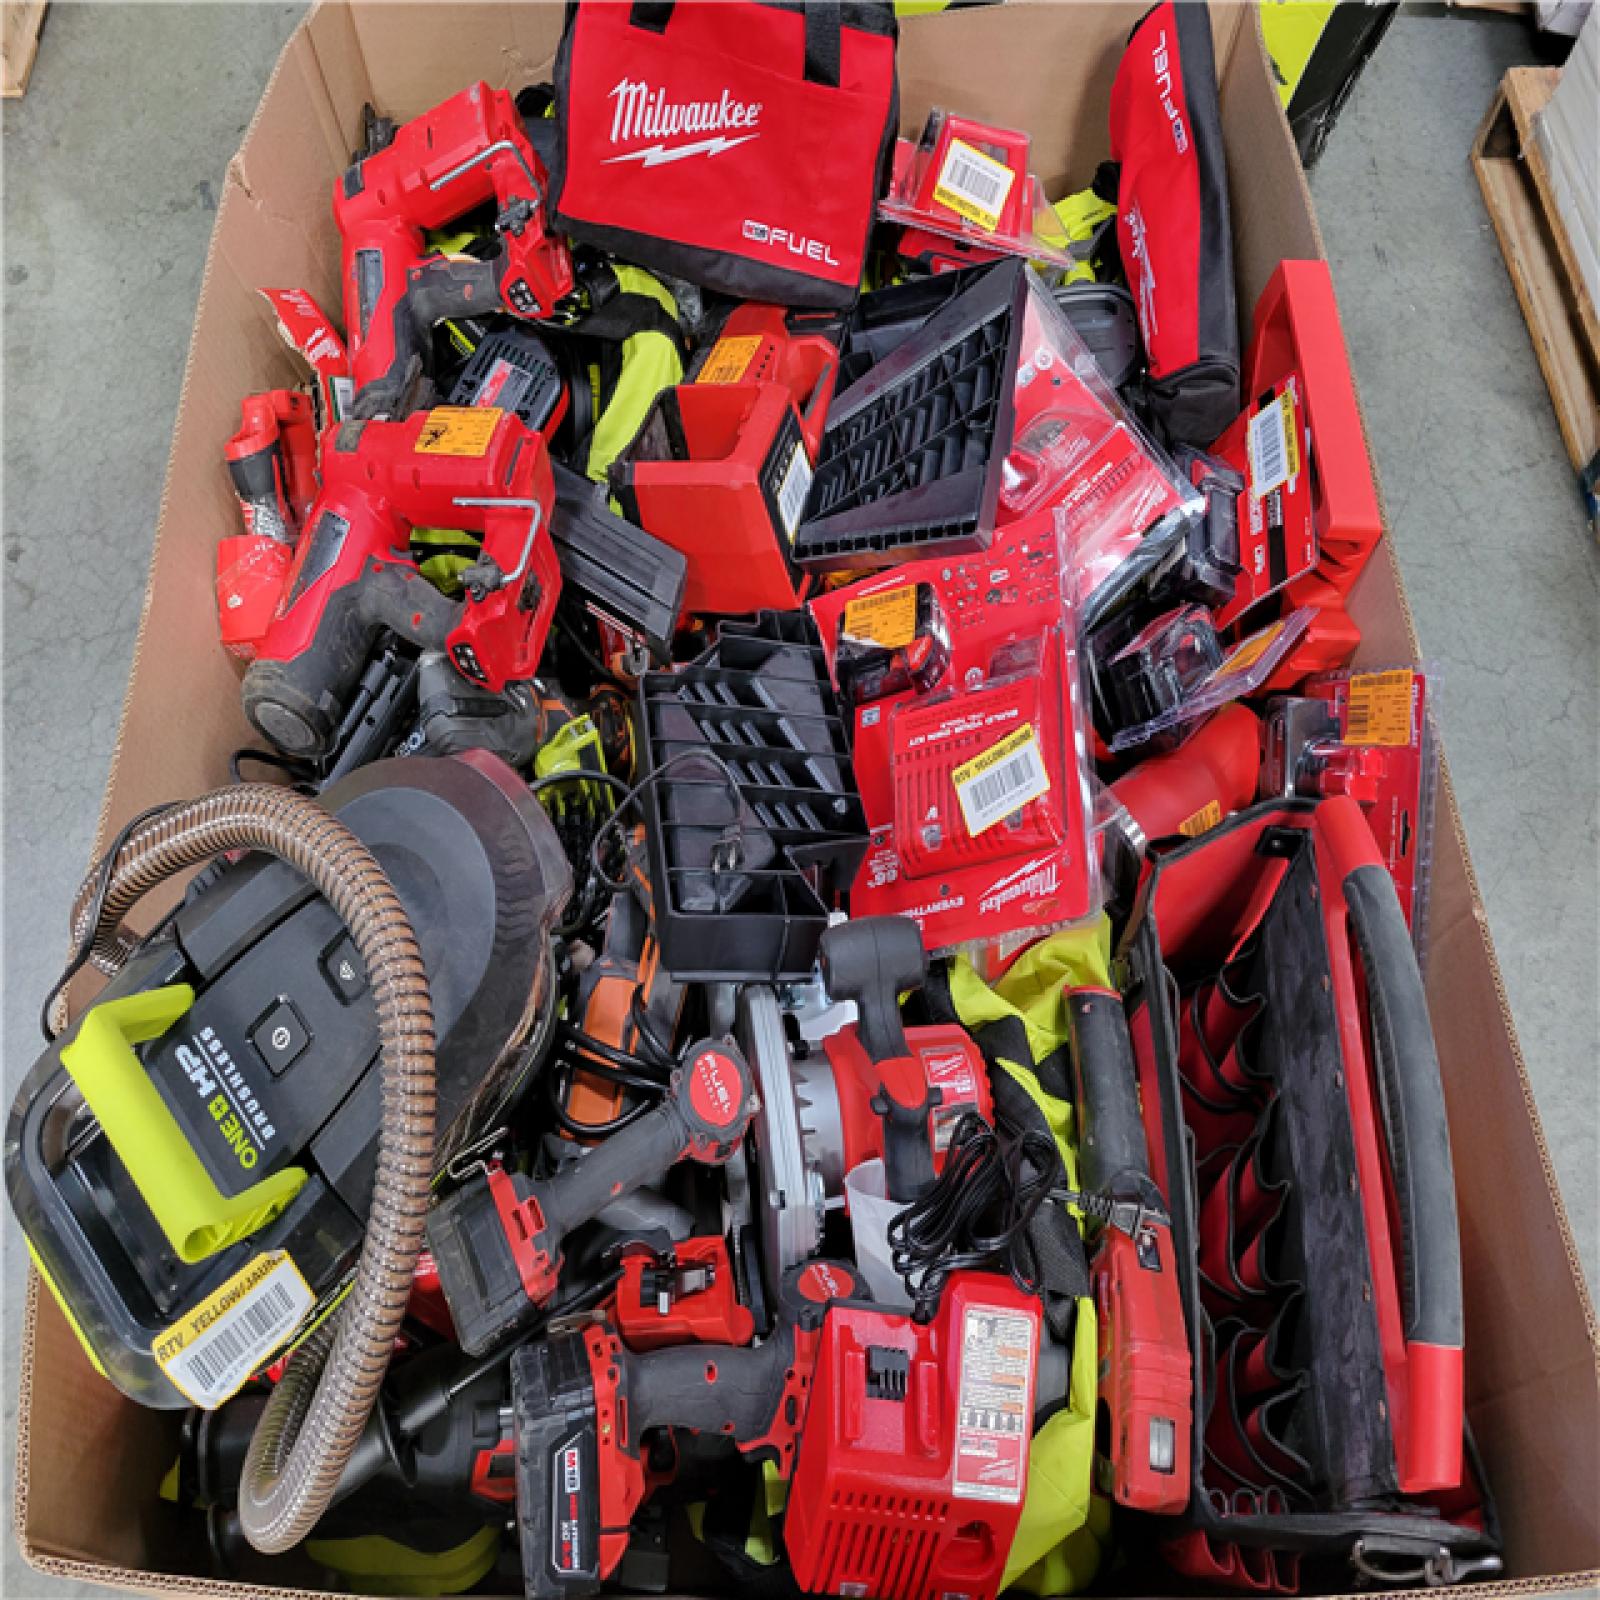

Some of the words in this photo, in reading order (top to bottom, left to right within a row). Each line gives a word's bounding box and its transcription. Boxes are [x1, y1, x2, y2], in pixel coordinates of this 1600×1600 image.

[1151, 29, 1180, 120] FUEL
[607, 77, 760, 143] Milwaukee
[769, 227, 840, 267] FUEL
[979, 862, 1063, 914] Milwaukee
[175, 1044, 217, 1098] HP
[200, 1026, 277, 1141] BRUSHLESS
[156, 1331, 186, 1362] RTV
[566, 1450, 579, 1491] M18
